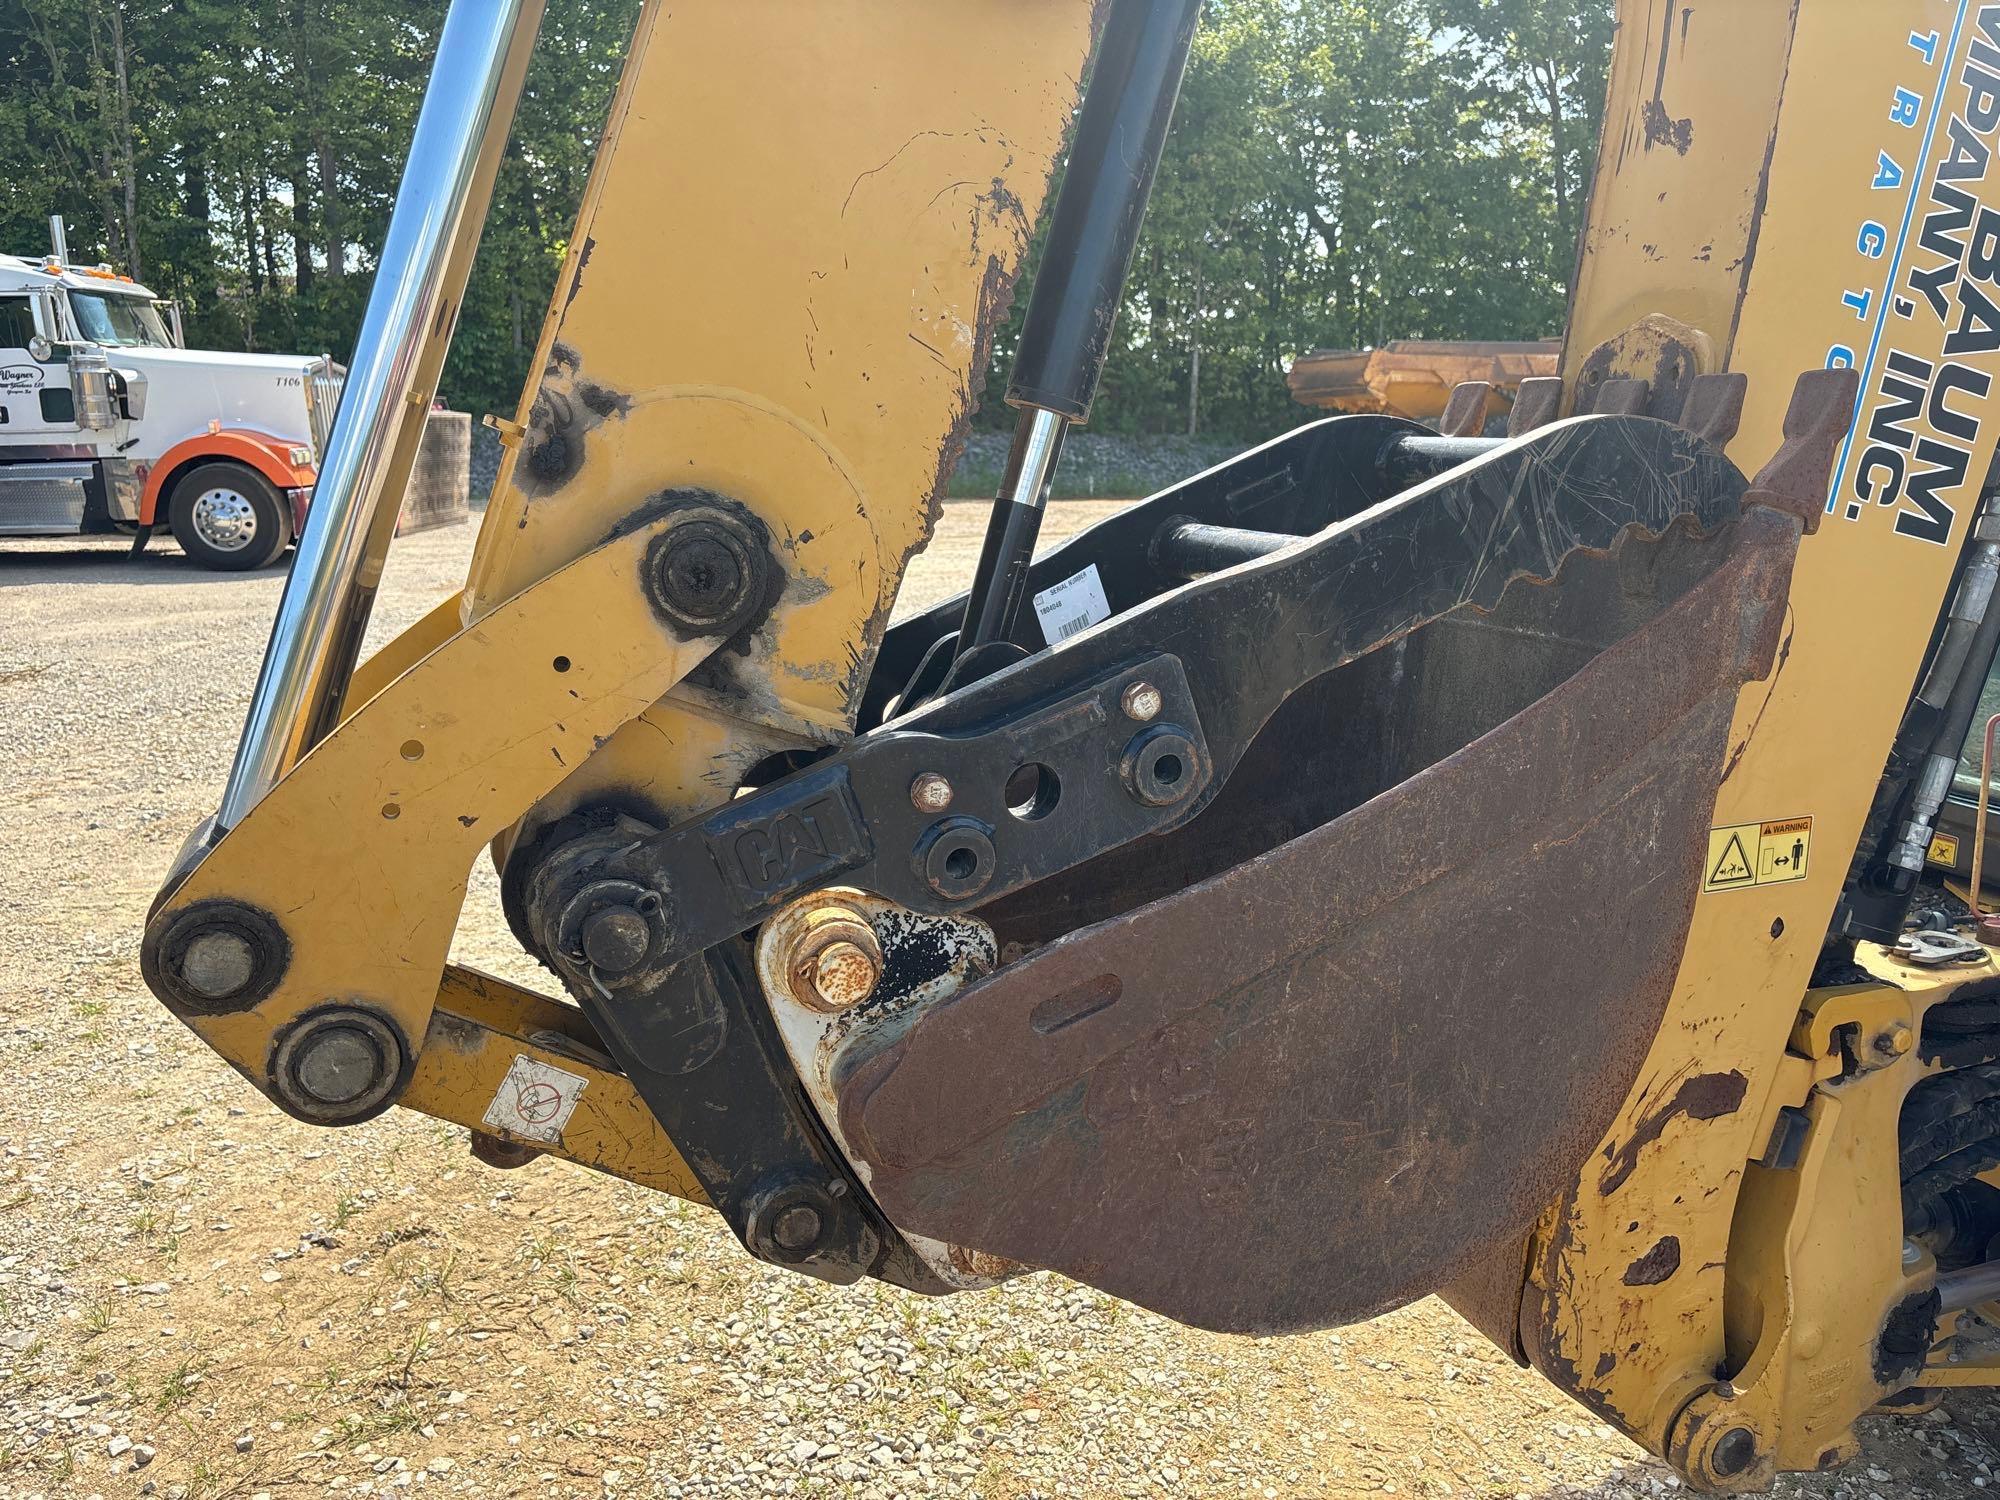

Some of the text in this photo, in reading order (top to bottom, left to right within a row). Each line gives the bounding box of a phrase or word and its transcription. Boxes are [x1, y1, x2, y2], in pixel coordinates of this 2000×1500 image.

[1845, 3, 2000, 523] PANY, INC.
[275, 376, 301, 387] T106
[1049, 570, 1087, 596] SERIAL NUMBER
[1772, 821, 1809, 834] WARNING
[734, 796, 838, 891] CAT
